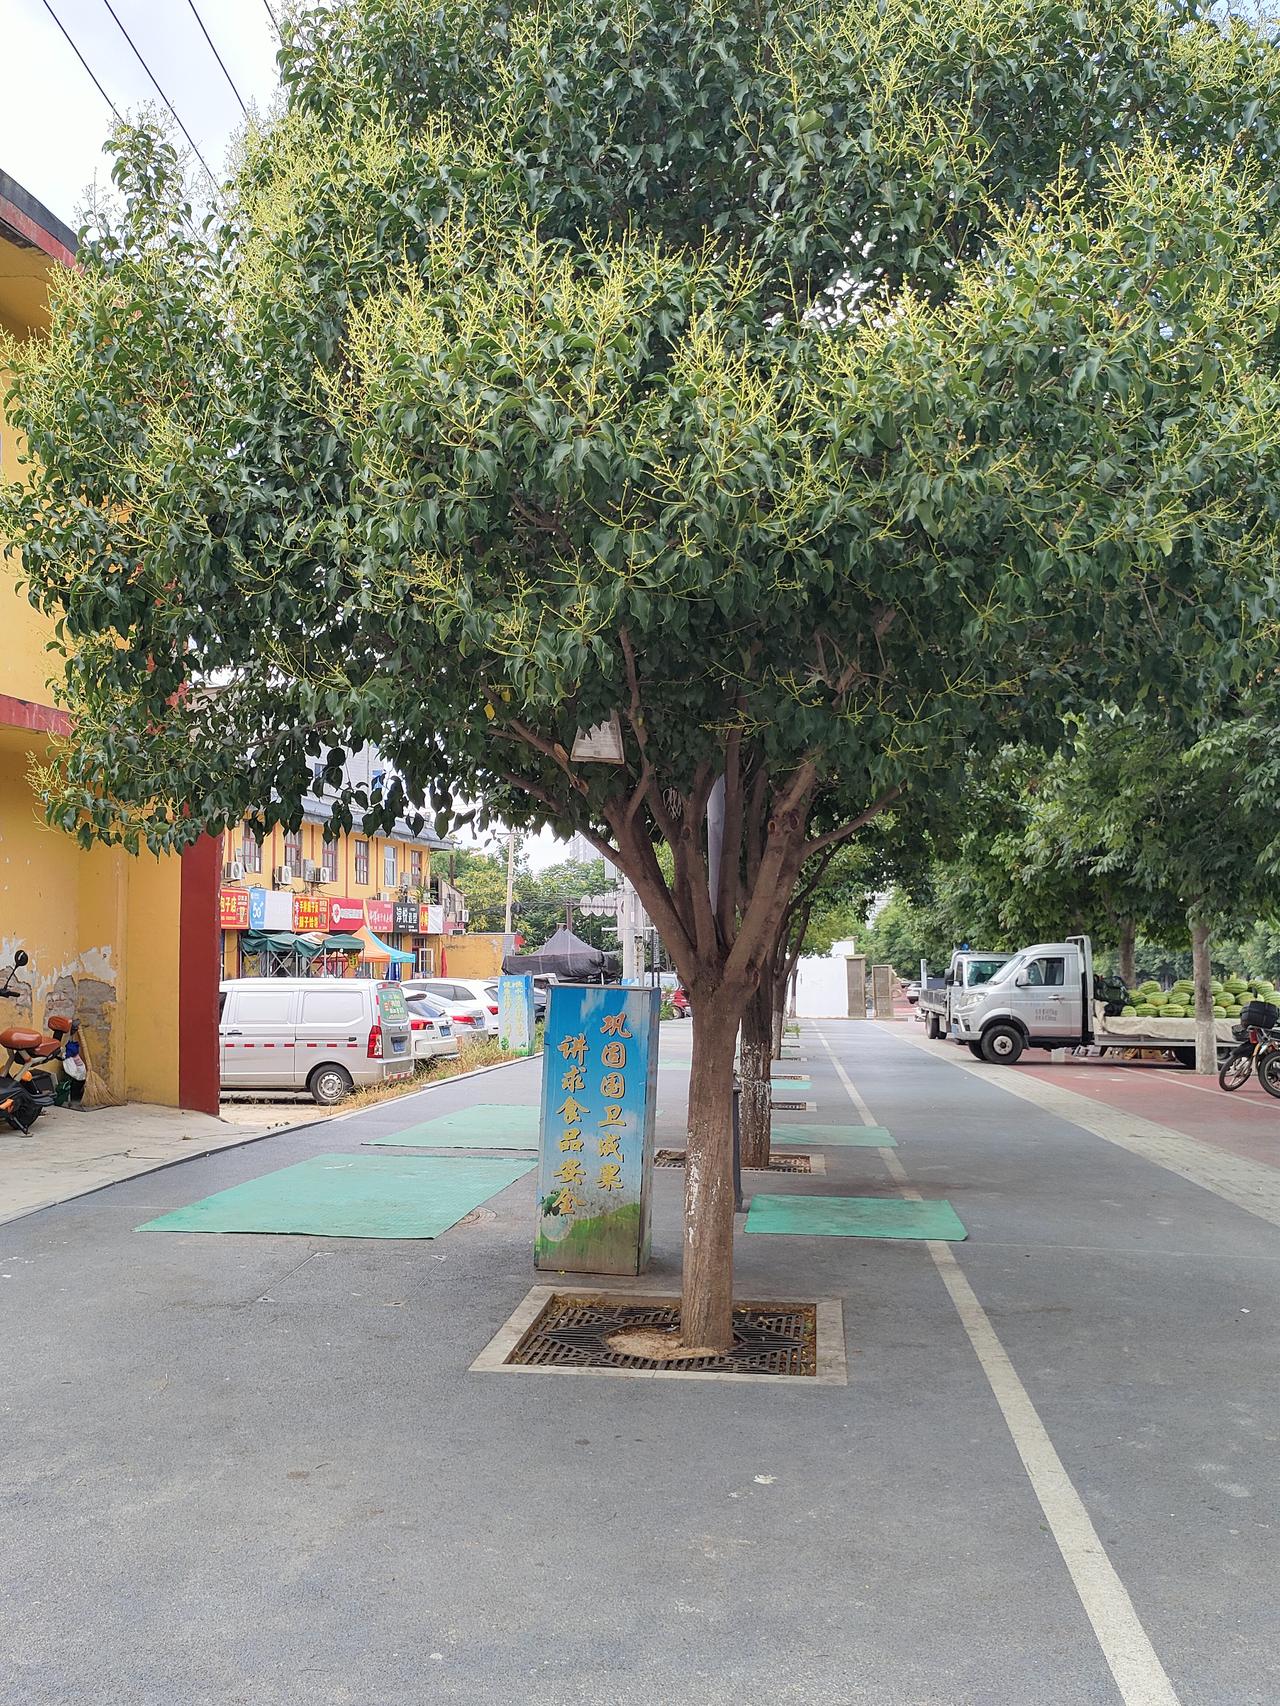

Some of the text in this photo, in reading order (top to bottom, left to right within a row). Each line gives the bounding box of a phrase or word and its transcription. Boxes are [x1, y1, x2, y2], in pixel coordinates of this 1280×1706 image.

[553, 1032, 590, 1215] 讲求食品安全
[597, 1012, 632, 1191] 巩固国卫成果
